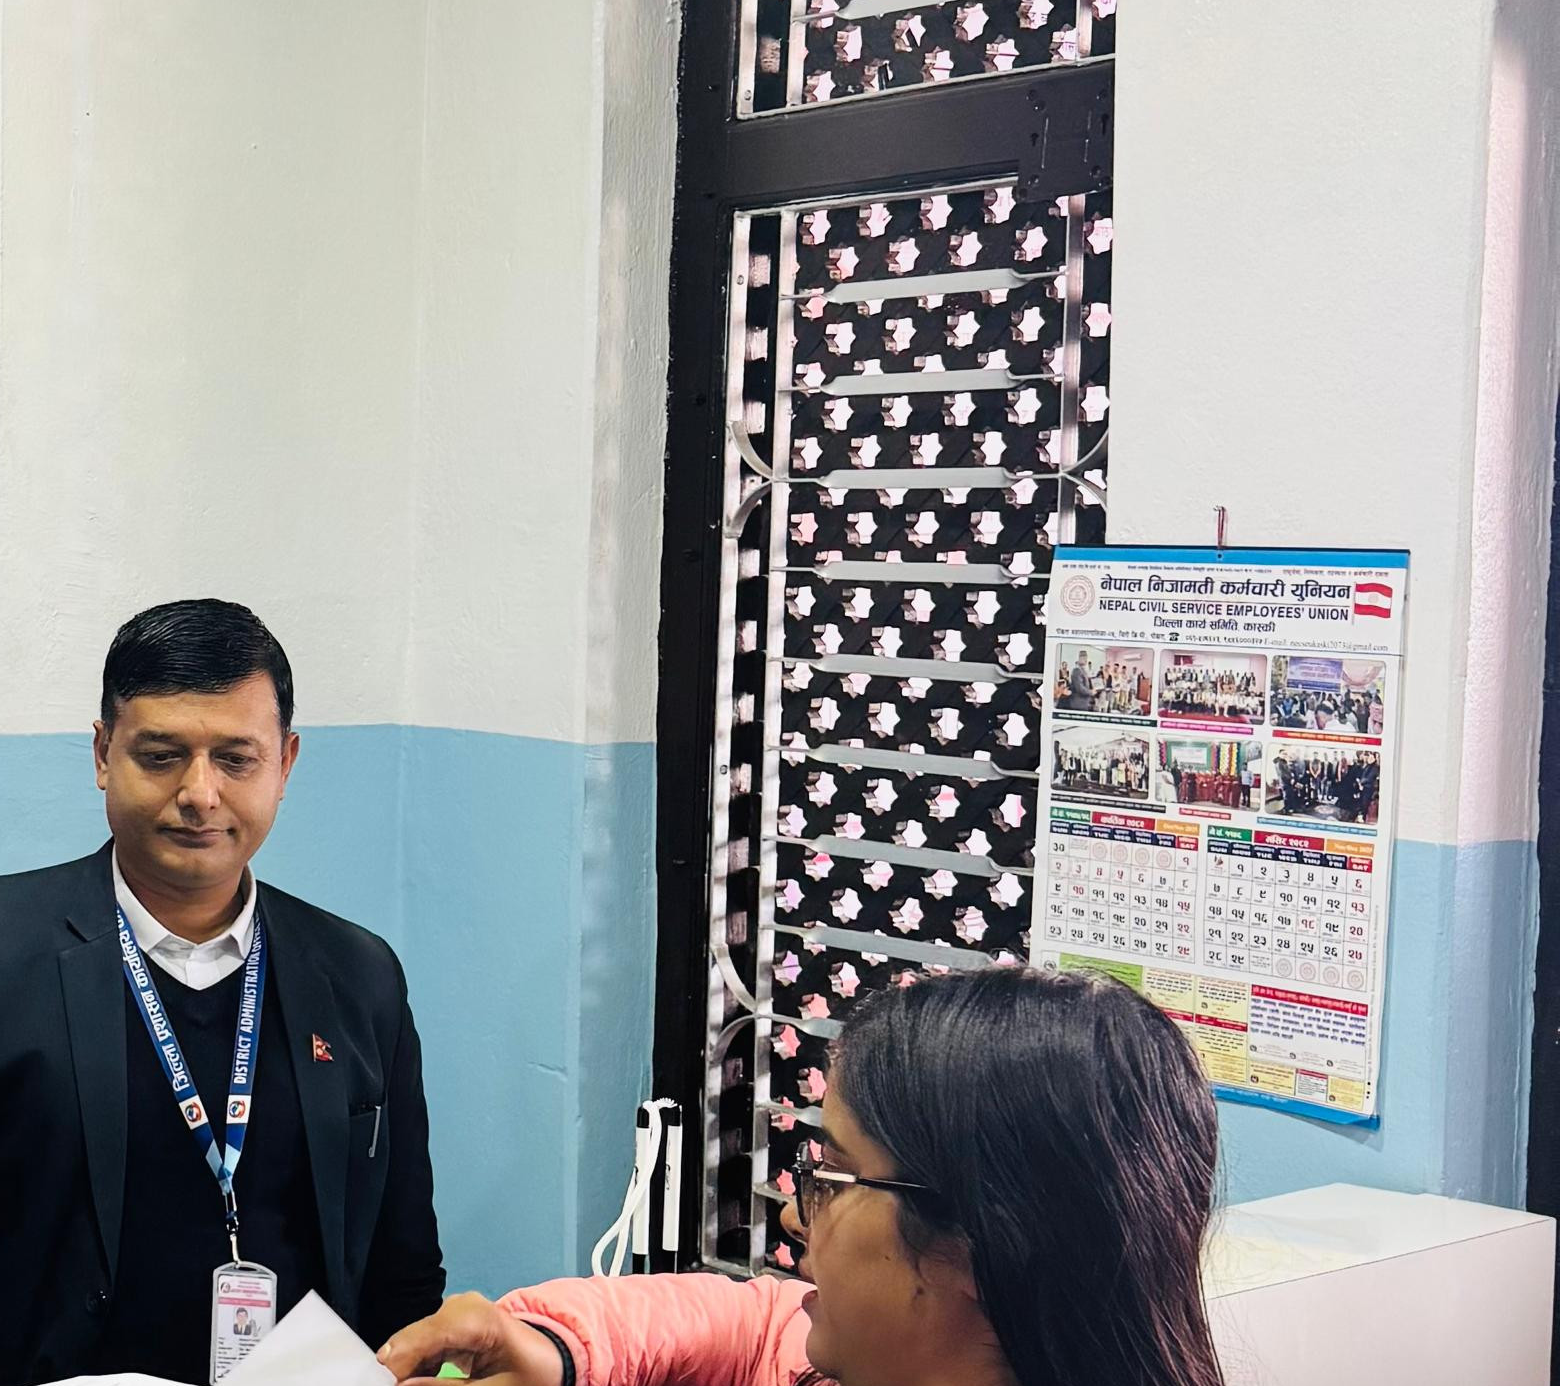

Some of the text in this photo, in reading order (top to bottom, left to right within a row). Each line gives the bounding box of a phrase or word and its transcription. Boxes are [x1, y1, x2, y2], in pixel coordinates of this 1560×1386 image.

[1100, 574, 1352, 602] नेपाल निजामती कर्मचारी युनियन
[1099, 599, 1136, 612] NEPAL
[1139, 601, 1169, 614] CIVIL
[1171, 602, 1222, 616] SERVICE
[1308, 607, 1349, 621] UNION
[1054, 843, 1064, 851] ३०
[1073, 886, 1084, 894] १०
[1093, 890, 1104, 898] ११
[1114, 893, 1125, 901] १२
[1135, 896, 1146, 904] १३
[1156, 899, 1167, 907] १४
[1178, 902, 1190, 911] १५
[1280, 893, 1292, 902] १०
[1304, 896, 1316, 905] ११
[1327, 900, 1340, 909] १२
[1352, 903, 1364, 912] १३
[1051, 904, 1189, 933] १६ १७ १८ १९ २० २१ २२
[1209, 907, 1362, 935] १४ १५ १६ १७ १८ १९ २०
[1050, 926, 1189, 955] २३ २४ २५ २६ २७ २८ २९
[1209, 929, 1362, 959] २१ २२ २३ २४ २५ २६ २७
[1210, 952, 1244, 964] २८ २९
[141, 990, 173, 1042] प्रशासन
[233, 1036, 252, 1085] DISTRICT
